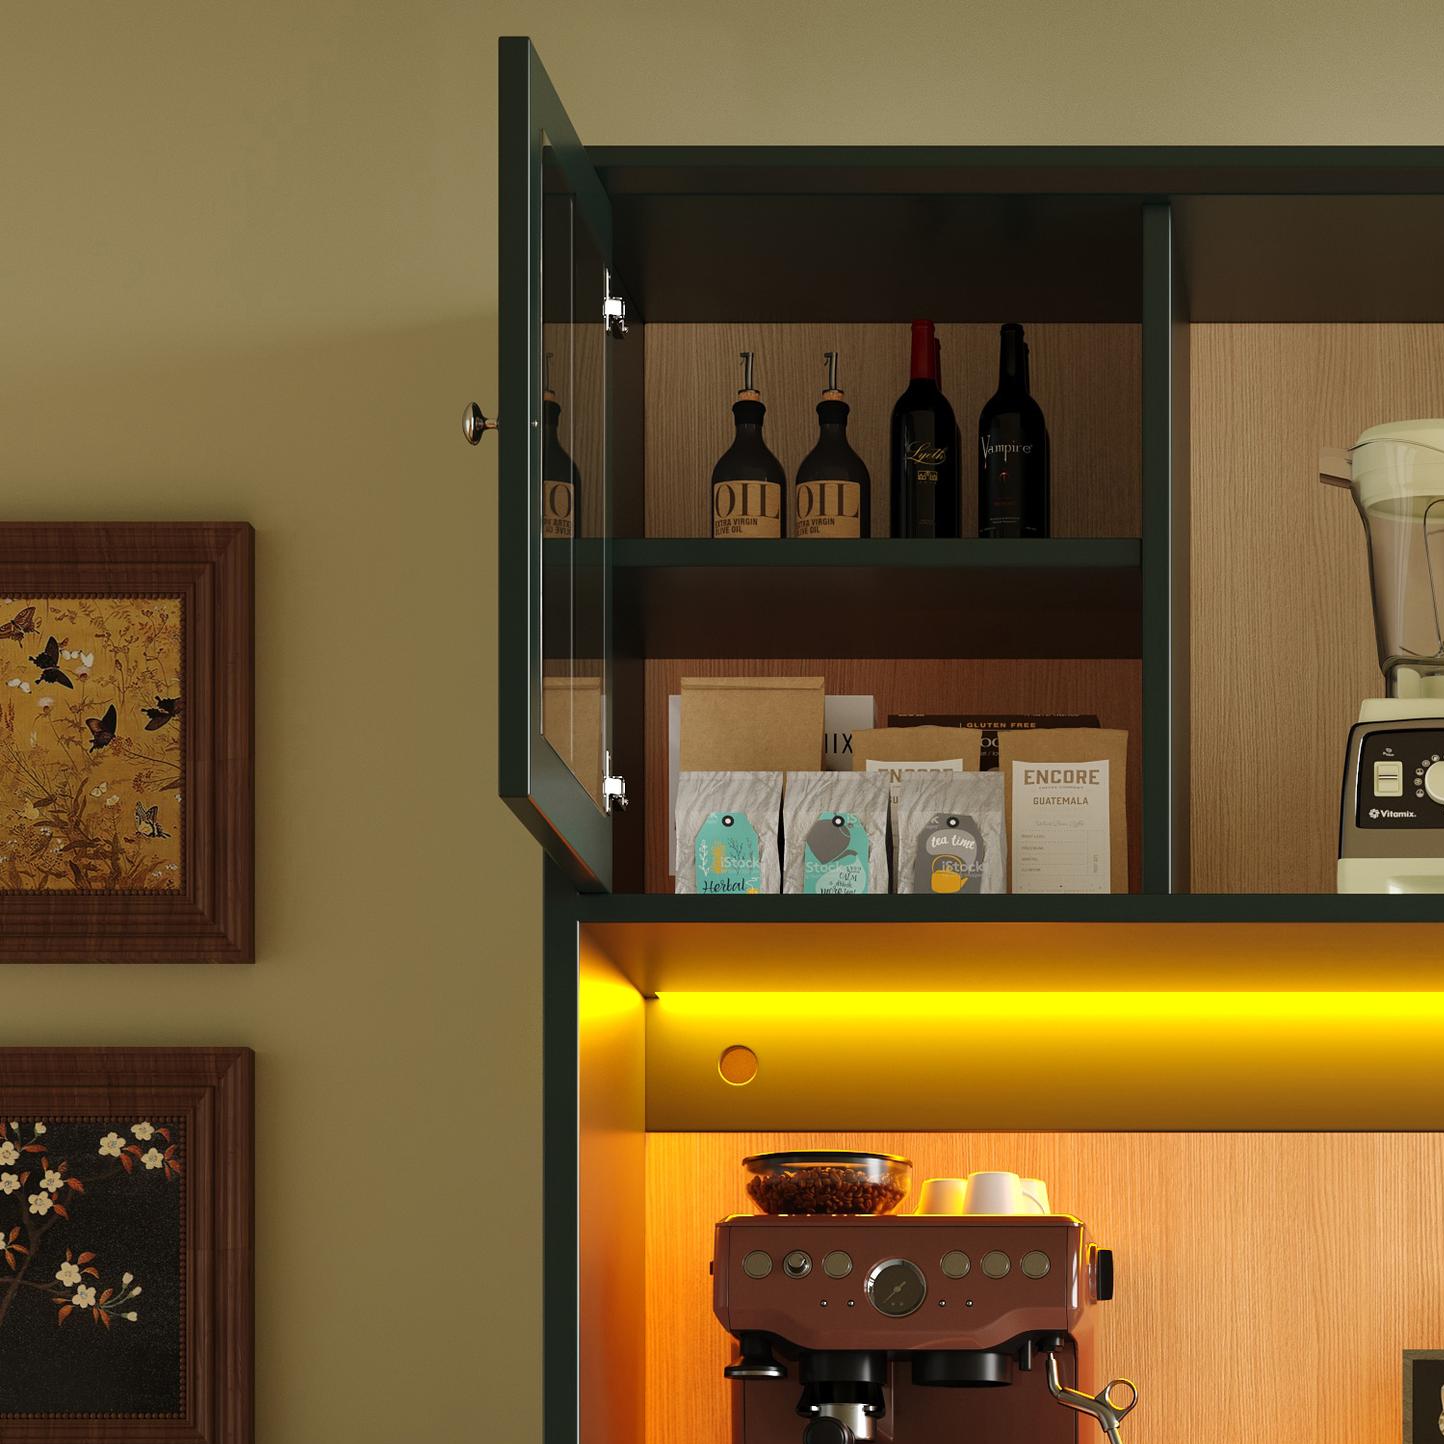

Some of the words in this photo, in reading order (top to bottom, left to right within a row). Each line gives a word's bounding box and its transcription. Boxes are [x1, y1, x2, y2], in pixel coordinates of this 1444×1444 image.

[981, 434, 1031, 469] Vampire
[715, 484, 780, 519] OIL
[797, 484, 859, 518] OIL
[733, 518, 758, 526] VIRGIN
[811, 518, 835, 526] VIRGIN
[1023, 769, 1100, 785] ENCORE
[1033, 796, 1089, 806] GUATEMALA
[1380, 809, 1413, 818] Vitamix
[931, 836, 949, 848] tea
[951, 834, 975, 850] time
[703, 878, 745, 894] Herbal
